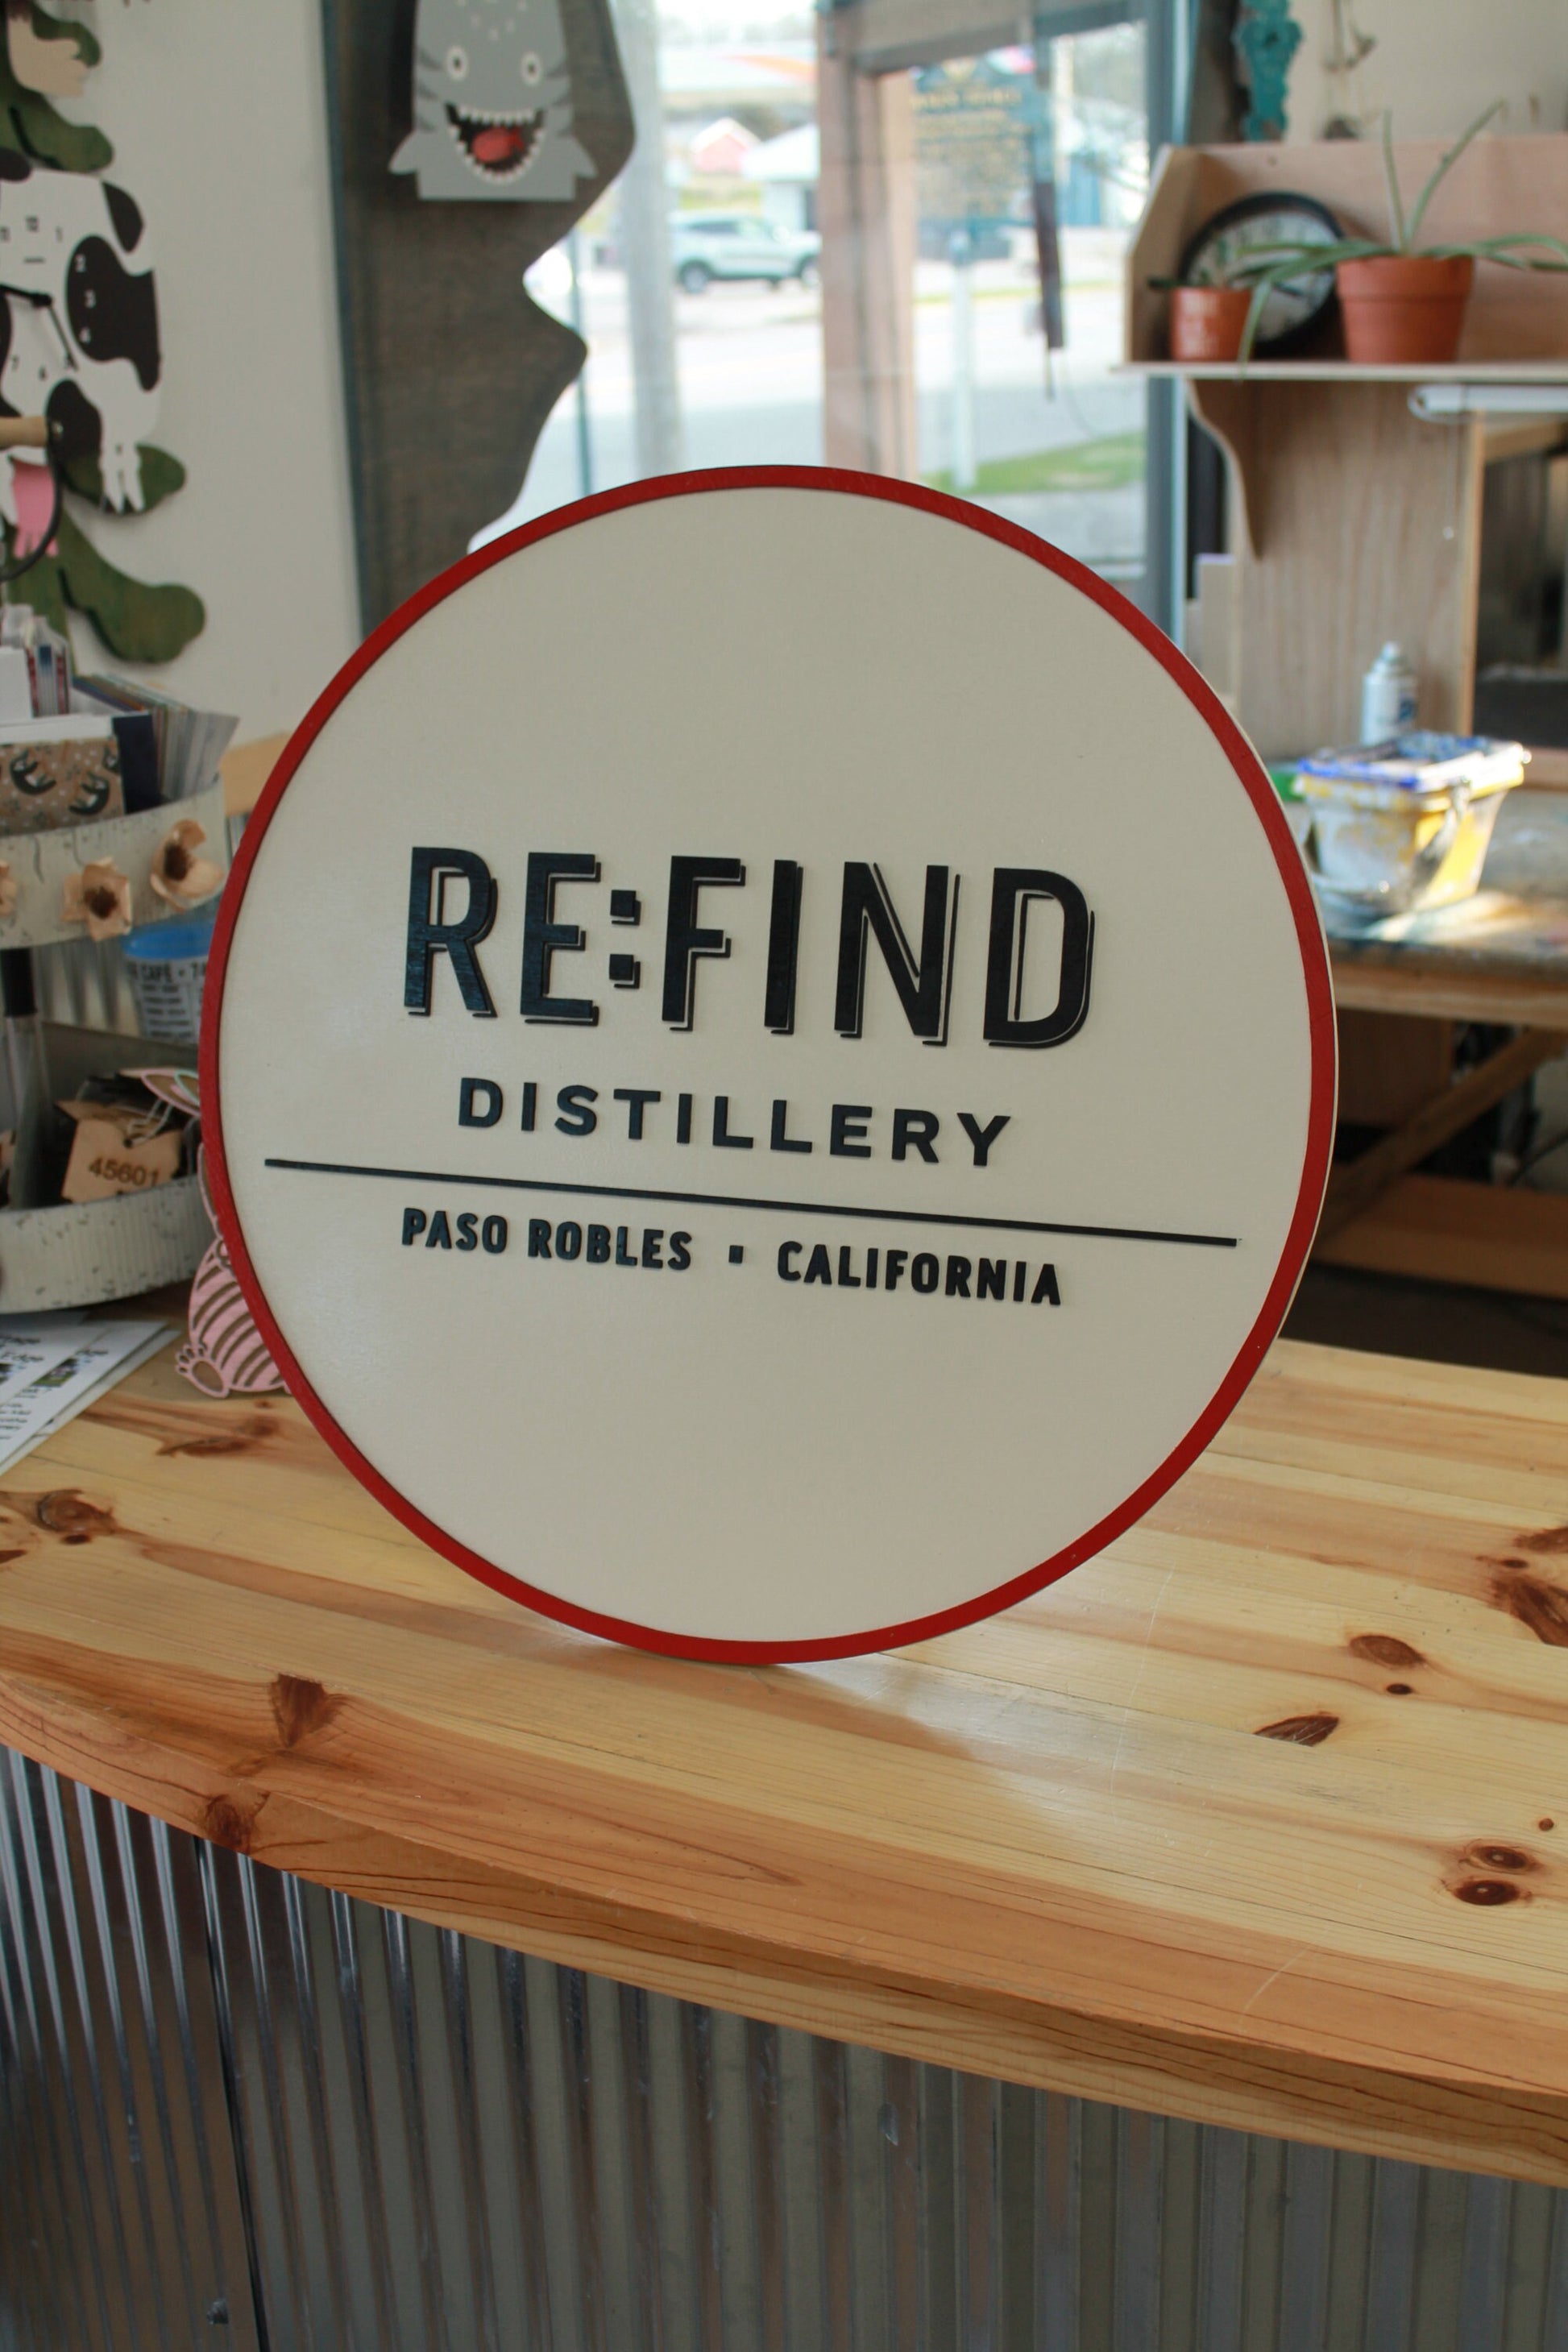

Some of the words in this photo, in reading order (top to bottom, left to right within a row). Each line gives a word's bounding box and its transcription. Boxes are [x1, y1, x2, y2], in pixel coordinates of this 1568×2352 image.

[403, 846, 1095, 1051] RE:FIND
[459, 1078, 1010, 1167] DISTILLERY
[89, 1158, 159, 1187] 45601
[401, 1207, 508, 1254] PASO
[528, 1218, 693, 1271] ROBLES
[777, 1240, 1062, 1307] CALIFORNIA
